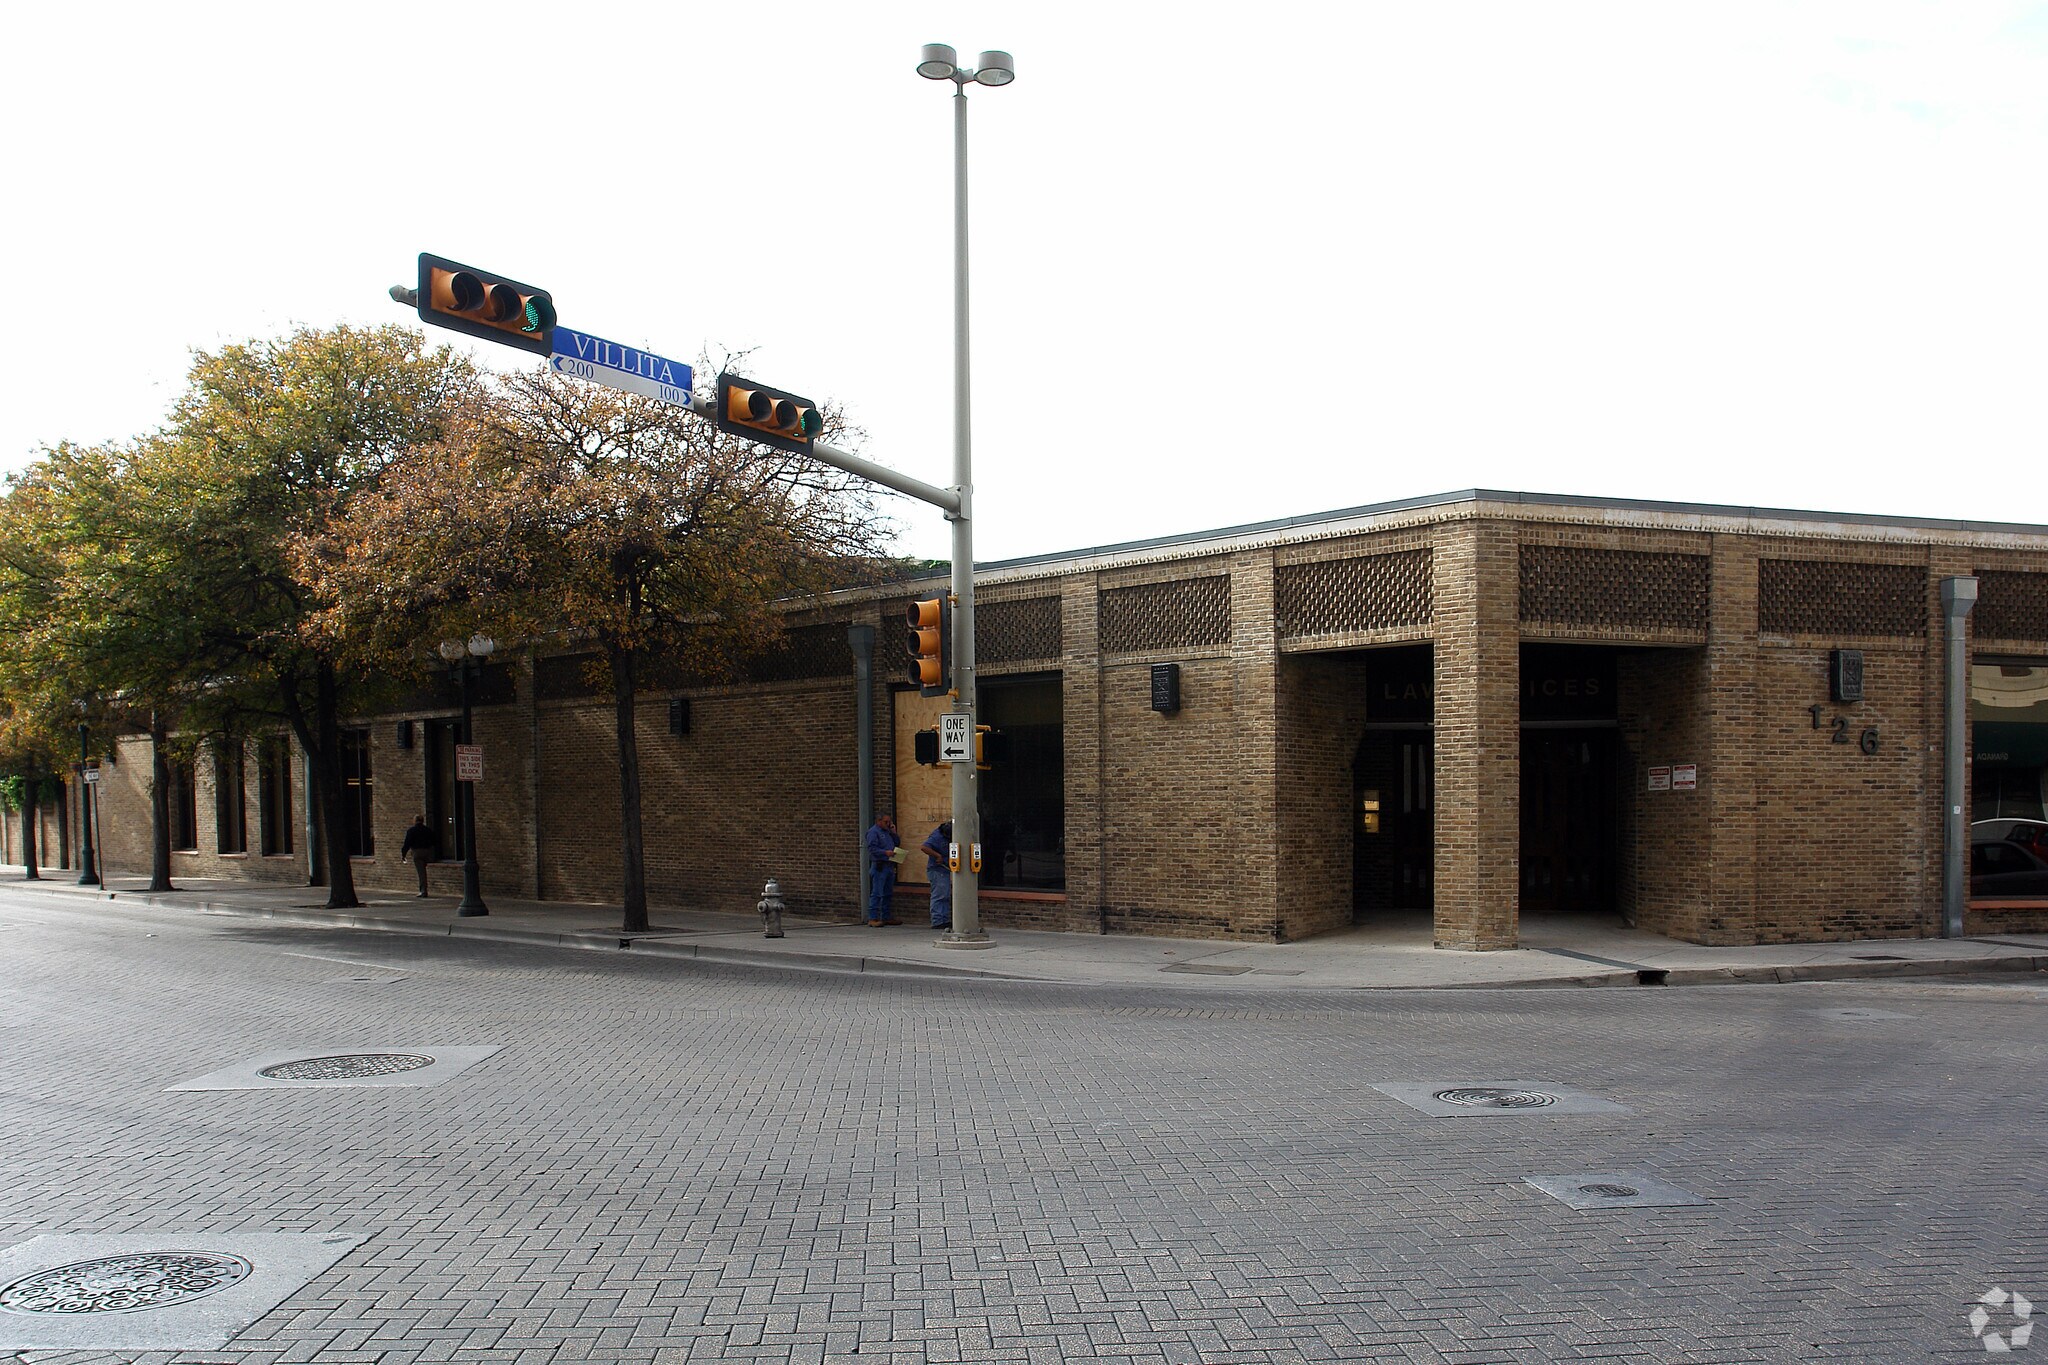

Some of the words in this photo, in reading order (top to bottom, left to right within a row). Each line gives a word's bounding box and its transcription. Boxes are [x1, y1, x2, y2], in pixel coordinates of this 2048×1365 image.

[571, 332, 677, 385] VILLITA
[568, 359, 594, 379] 200
[659, 384, 680, 403] 100
[1529, 678, 1600, 698] ICES
[946, 718, 965, 730] ONE
[945, 731, 965, 743] WAY
